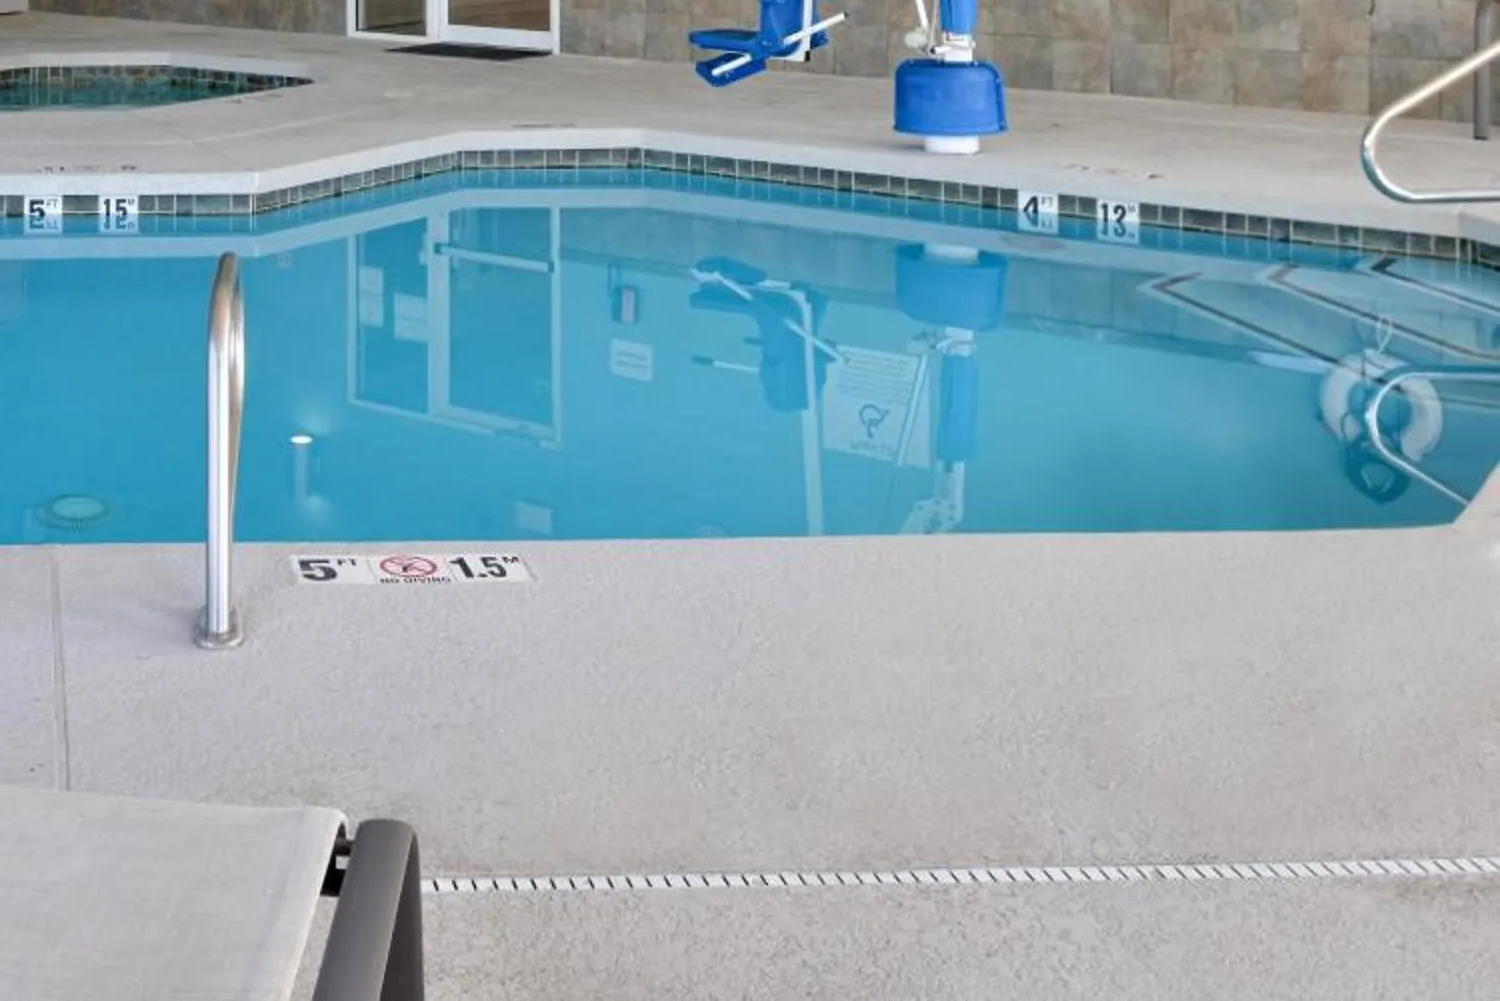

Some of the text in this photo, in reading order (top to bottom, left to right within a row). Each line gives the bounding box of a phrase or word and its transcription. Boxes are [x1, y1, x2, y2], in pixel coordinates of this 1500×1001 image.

[298, 558, 357, 581] 5 FT
[449, 556, 519, 579] 1.5 M
